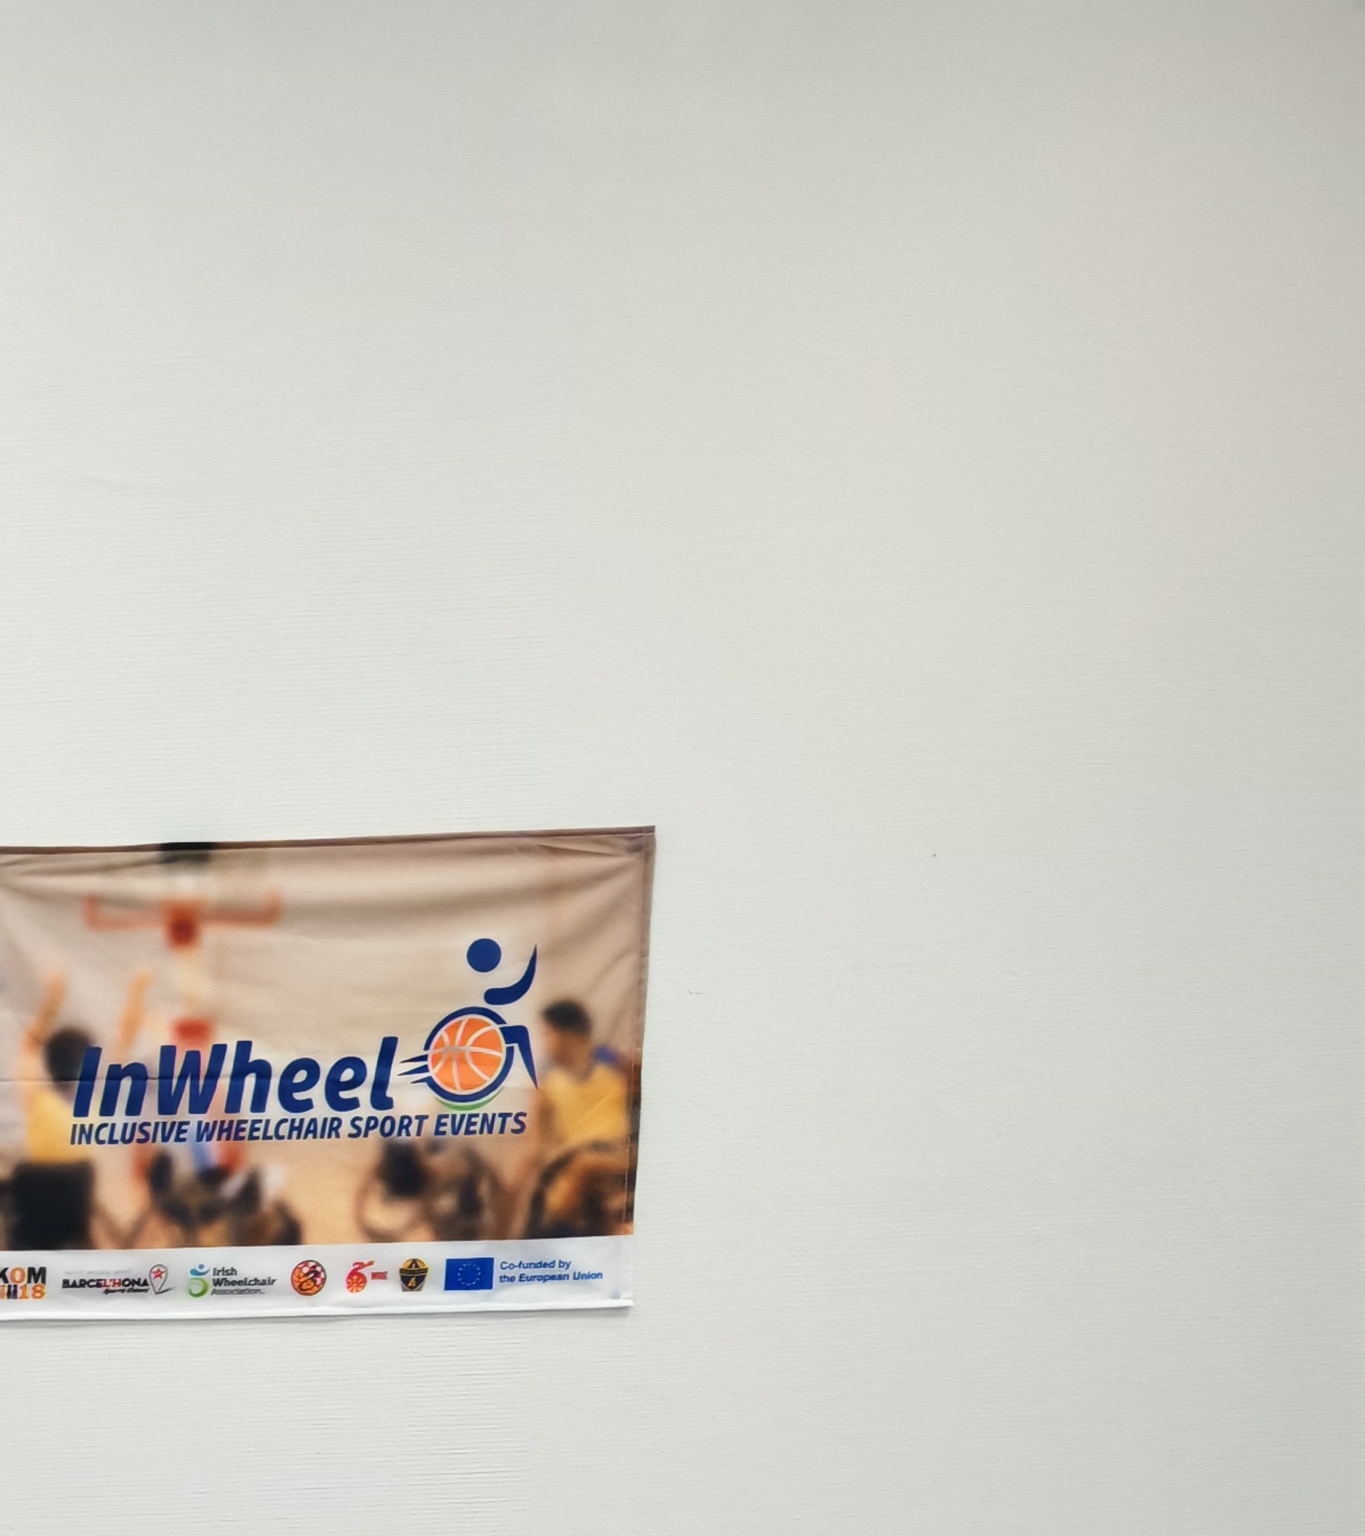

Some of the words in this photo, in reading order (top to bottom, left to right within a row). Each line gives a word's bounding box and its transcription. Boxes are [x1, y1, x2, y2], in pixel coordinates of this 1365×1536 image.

[73, 1036, 398, 1117] InWheel
[70, 1121, 190, 1145] INCLUSIVE
[196, 1116, 342, 1142] WHEELCHAIR
[347, 1114, 429, 1139] SPORT
[434, 1111, 527, 1136] EVENTS
[212, 1267, 238, 1276] Irish
[500, 1260, 555, 1271] Co-funded
[558, 1260, 572, 1270] by
[212, 1277, 277, 1287] Wheelchair
[499, 1274, 516, 1283] the
[519, 1272, 570, 1284] European
[572, 1270, 604, 1281] Union
[19, 1284, 47, 1300] 18
